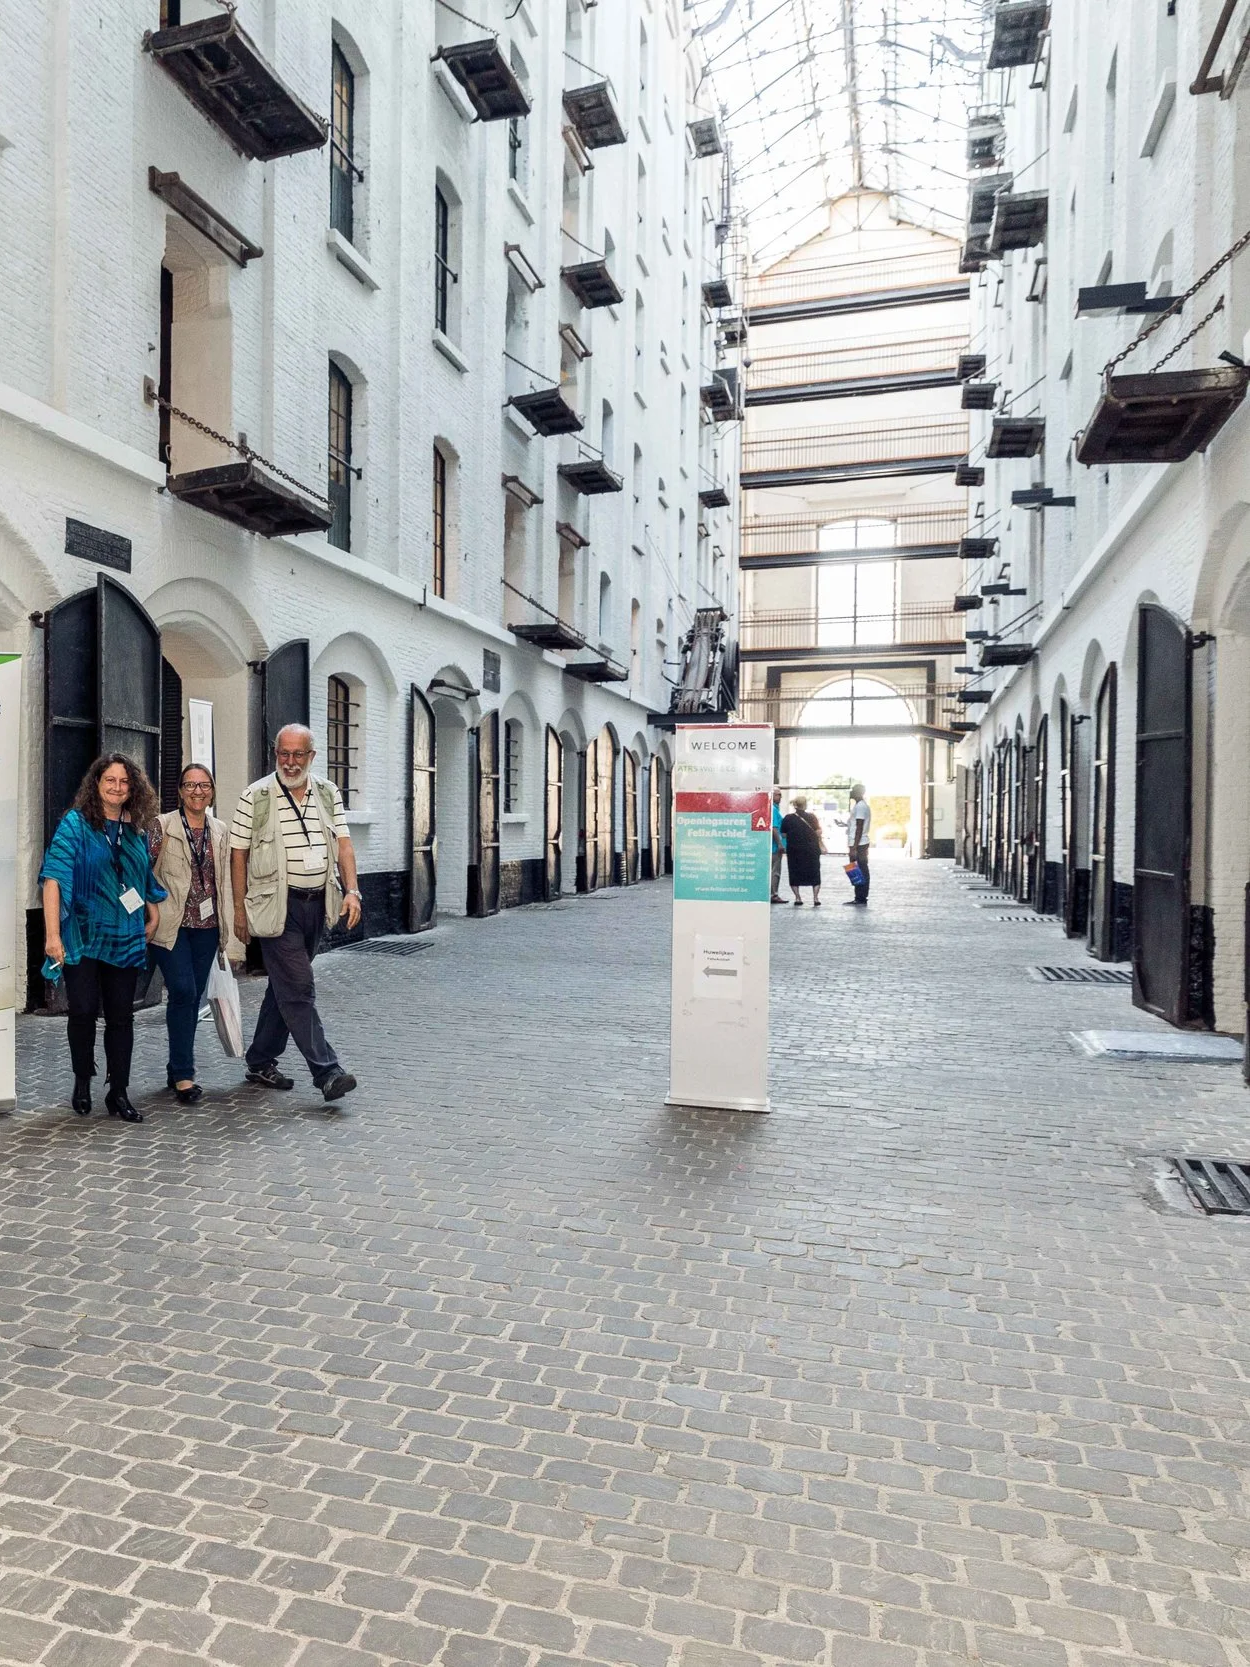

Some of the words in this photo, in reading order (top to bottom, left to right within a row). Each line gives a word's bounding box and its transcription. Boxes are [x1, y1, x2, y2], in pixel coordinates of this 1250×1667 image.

[691, 741, 757, 750] WELCOME
[677, 816, 747, 827] Openingsuren
[687, 828, 747, 838] FelixArchief
